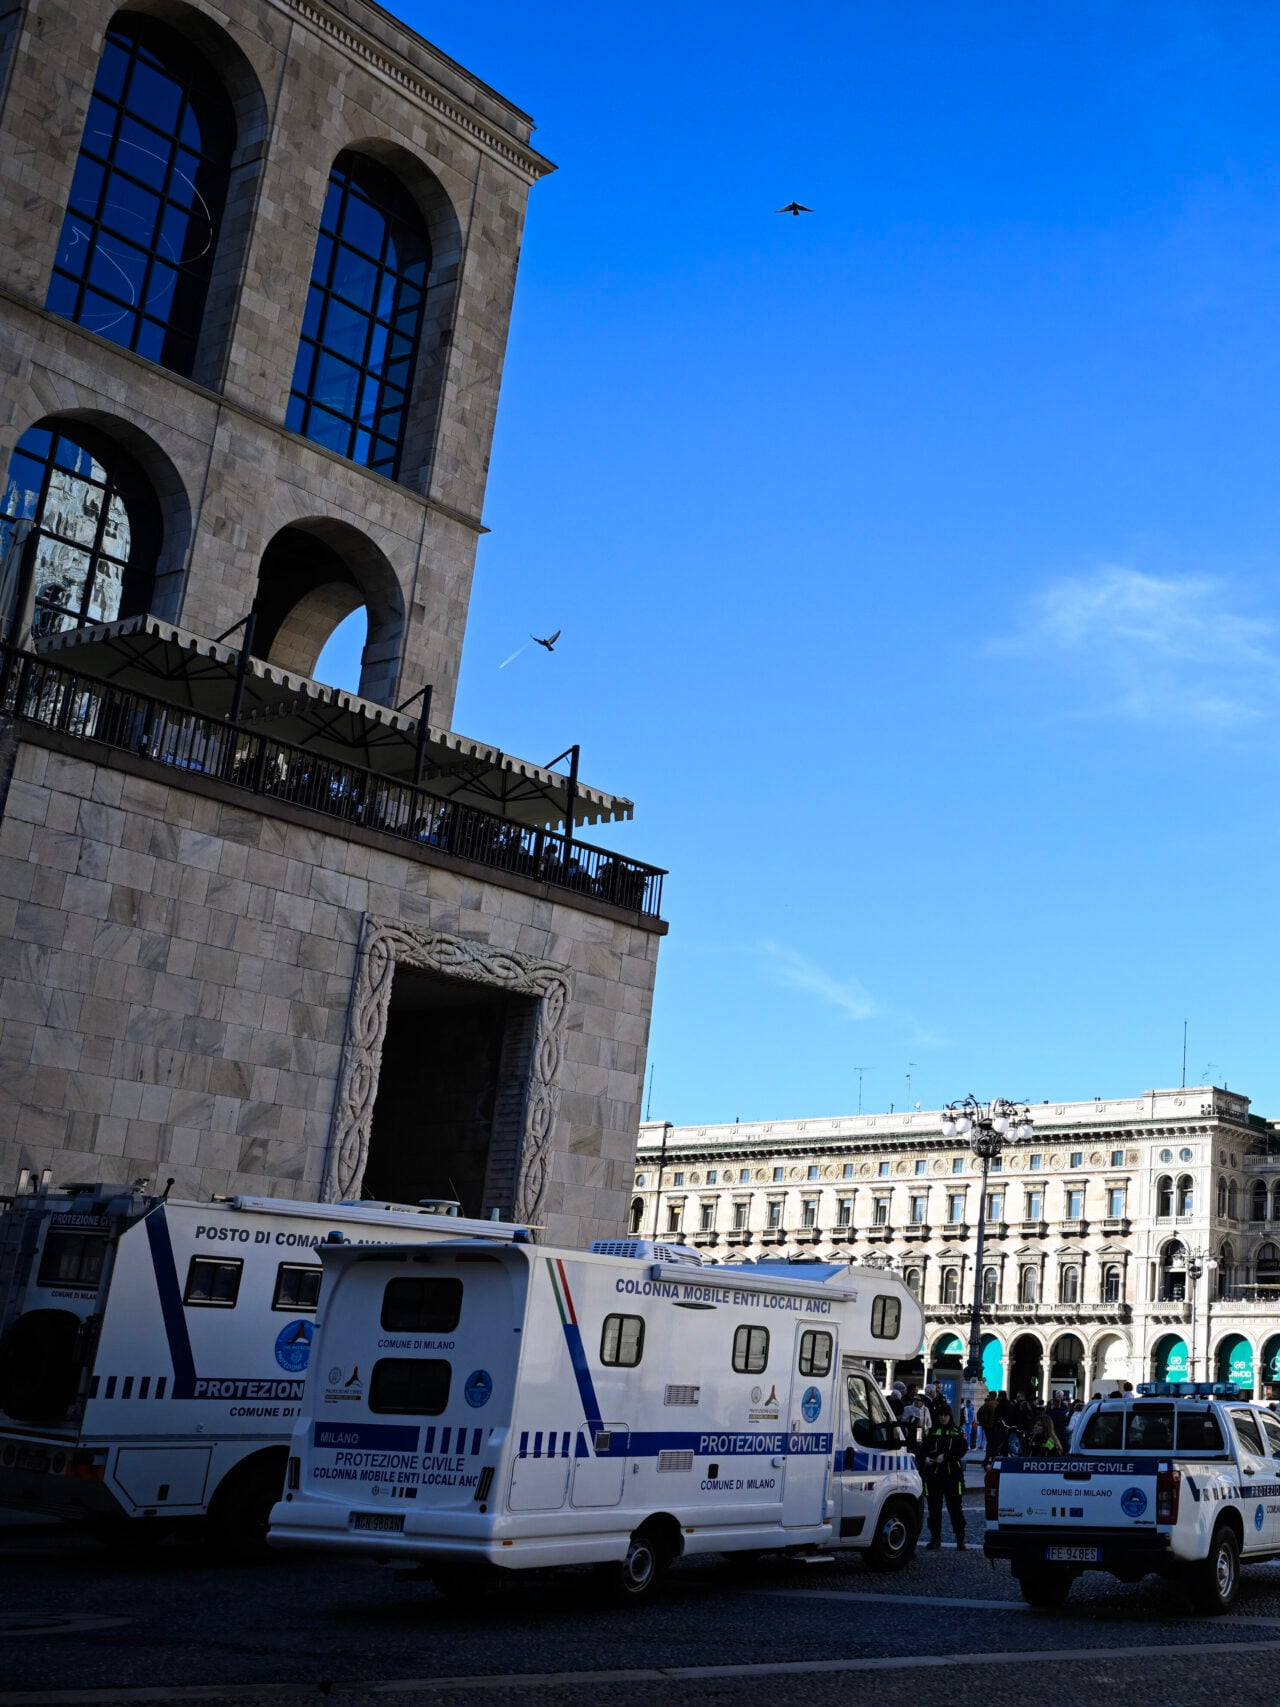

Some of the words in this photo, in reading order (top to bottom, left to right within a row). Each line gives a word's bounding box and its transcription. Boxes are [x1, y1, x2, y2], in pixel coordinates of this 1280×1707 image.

[52, 1214, 99, 1226] PROTEZIONE
[195, 1225, 250, 1243] POSTO
[254, 1230, 271, 1244] DI
[81, 1292, 97, 1300] MILAN
[615, 1278, 679, 1299] COLONNA
[683, 1285, 729, 1304] MOBILE
[732, 1290, 760, 1307] ENTI
[762, 1294, 803, 1311] LOCALI
[805, 1301, 831, 1314] ANCI
[377, 1339, 412, 1350] COMUNE
[413, 1340, 422, 1350] DI
[423, 1340, 456, 1351] MILANO
[193, 1380, 305, 1398] PROTEZION
[229, 1407, 280, 1417] COMUNE
[282, 1407, 294, 1417] DI
[319, 1431, 360, 1444] MILANO
[699, 1435, 782, 1453] PROTEZIONE
[789, 1435, 827, 1452] CIVILE
[335, 1452, 419, 1470] PROTEZIONE
[421, 1455, 465, 1472] CIVILE
[1022, 1461, 1096, 1473] PROTEZIONE
[1097, 1462, 1135, 1474] CIVILE
[313, 1467, 358, 1481] COLONNA
[359, 1469, 396, 1483] MOBILE
[397, 1471, 420, 1484] ENTI
[421, 1472, 457, 1486] LOCALI
[458, 1475, 479, 1488] ANC
[700, 1479, 735, 1491] COMUNE
[735, 1479, 744, 1490] DI
[746, 1478, 776, 1489] MILANO
[1041, 1488, 1072, 1496] COMUNE
[1074, 1489, 1082, 1497] DI
[1083, 1489, 1113, 1498] MILANO
[1050, 1547, 1063, 1560] FE
[1066, 1547, 1096, 1561] 948ES
